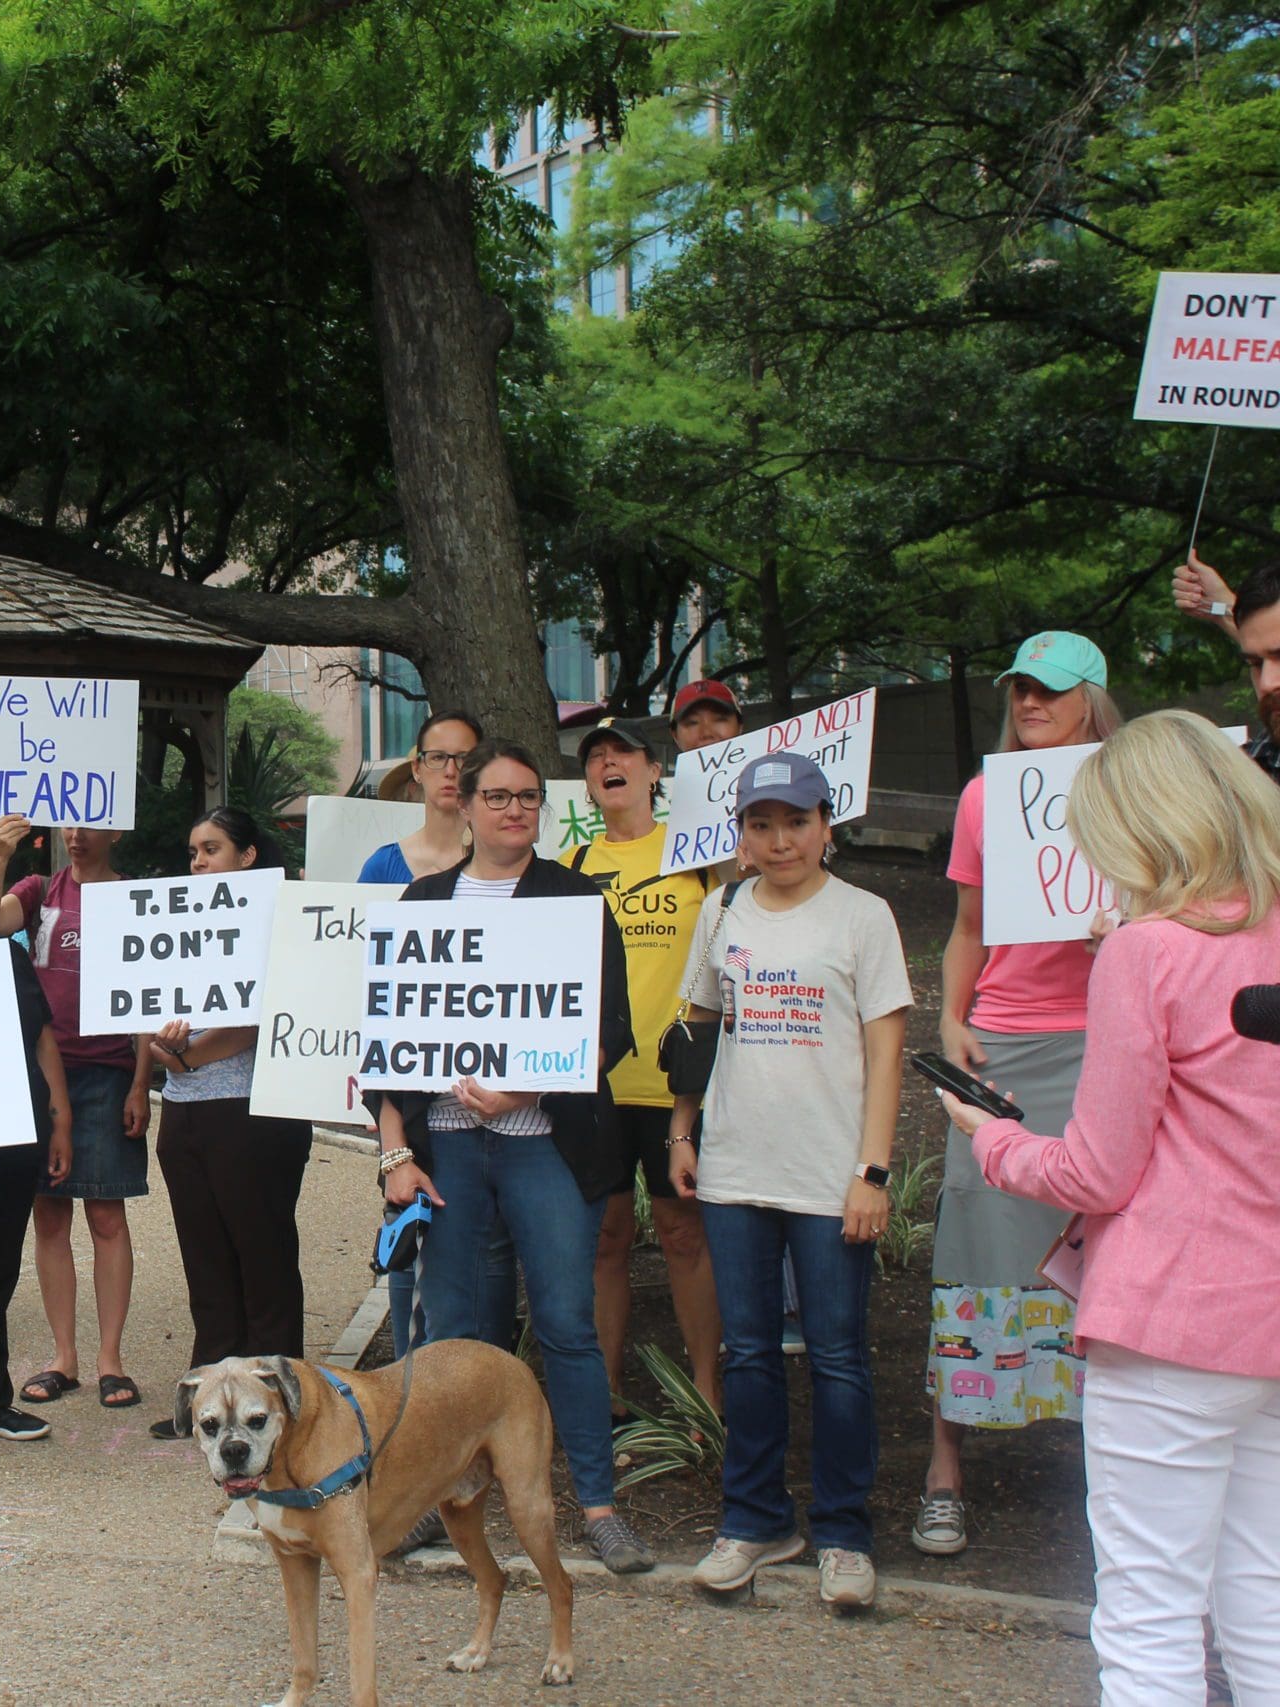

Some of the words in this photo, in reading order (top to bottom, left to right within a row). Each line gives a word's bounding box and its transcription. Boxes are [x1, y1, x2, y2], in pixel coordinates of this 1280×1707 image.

[1183, 294, 1277, 319] DON'T
[1157, 384, 1187, 405] IN
[1193, 385, 1280, 409] ROUND
[45, 680, 109, 719] Will
[20, 721, 56, 763] be
[697, 741, 747, 773] We
[767, 717, 802, 753] DO
[814, 690, 871, 737] NOT
[670, 818, 741, 867] RRIS
[129, 881, 249, 917] T.E.A.
[302, 904, 366, 942] Tak
[122, 928, 241, 962] DON'T
[370, 928, 484, 966] TAKE
[743, 983, 825, 999] co-parent
[745, 968, 750, 981] I
[756, 968, 797, 982] don't
[110, 980, 257, 1017] DELAY
[367, 981, 583, 1019] EFFECTIVE
[743, 1008, 785, 1020] Round
[790, 1009, 821, 1022] Rock
[779, 996, 802, 1006] with
[806, 998, 823, 1009] the
[270, 1012, 362, 1059] Roun
[740, 1021, 782, 1032] School
[785, 1022, 823, 1035] board.
[359, 1039, 508, 1078] ACTION
[513, 1037, 589, 1080] now!
